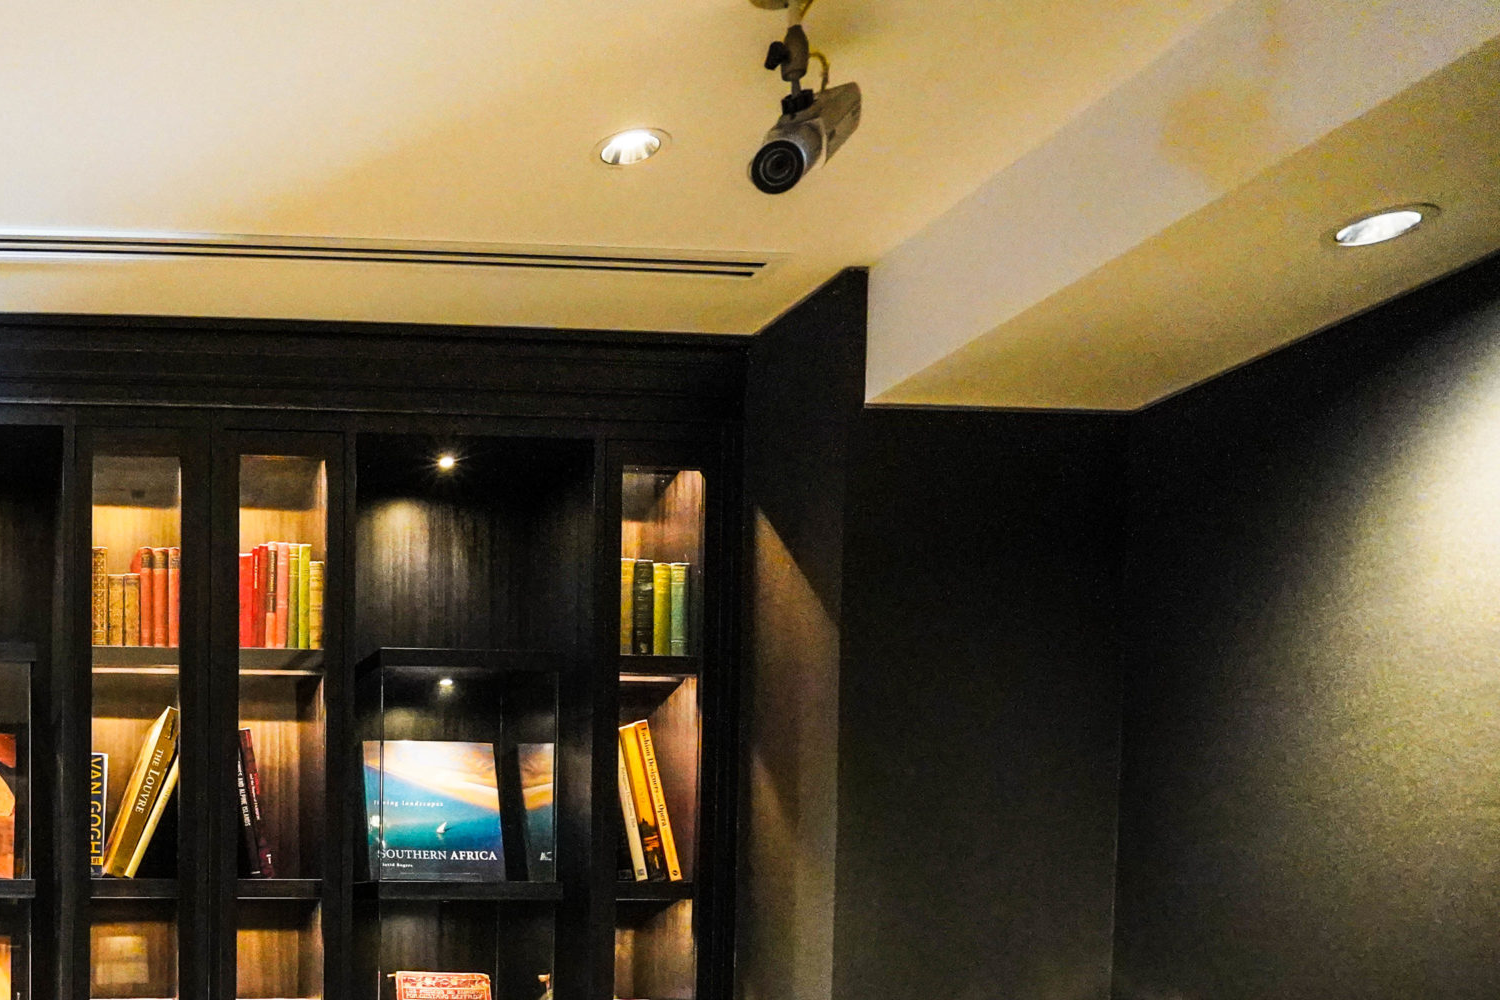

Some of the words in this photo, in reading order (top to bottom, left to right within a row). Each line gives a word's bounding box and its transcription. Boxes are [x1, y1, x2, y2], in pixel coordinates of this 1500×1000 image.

[152, 749, 165, 766] THE
[91, 757, 102, 794] VAN
[135, 768, 160, 813] LOUVRE
[402, 800, 444, 808] landscapes
[657, 804, 667, 827] Opera
[91, 801, 101, 854] GOGH
[378, 849, 447, 860] SOUTHERN
[450, 850, 498, 861] AFRICA
